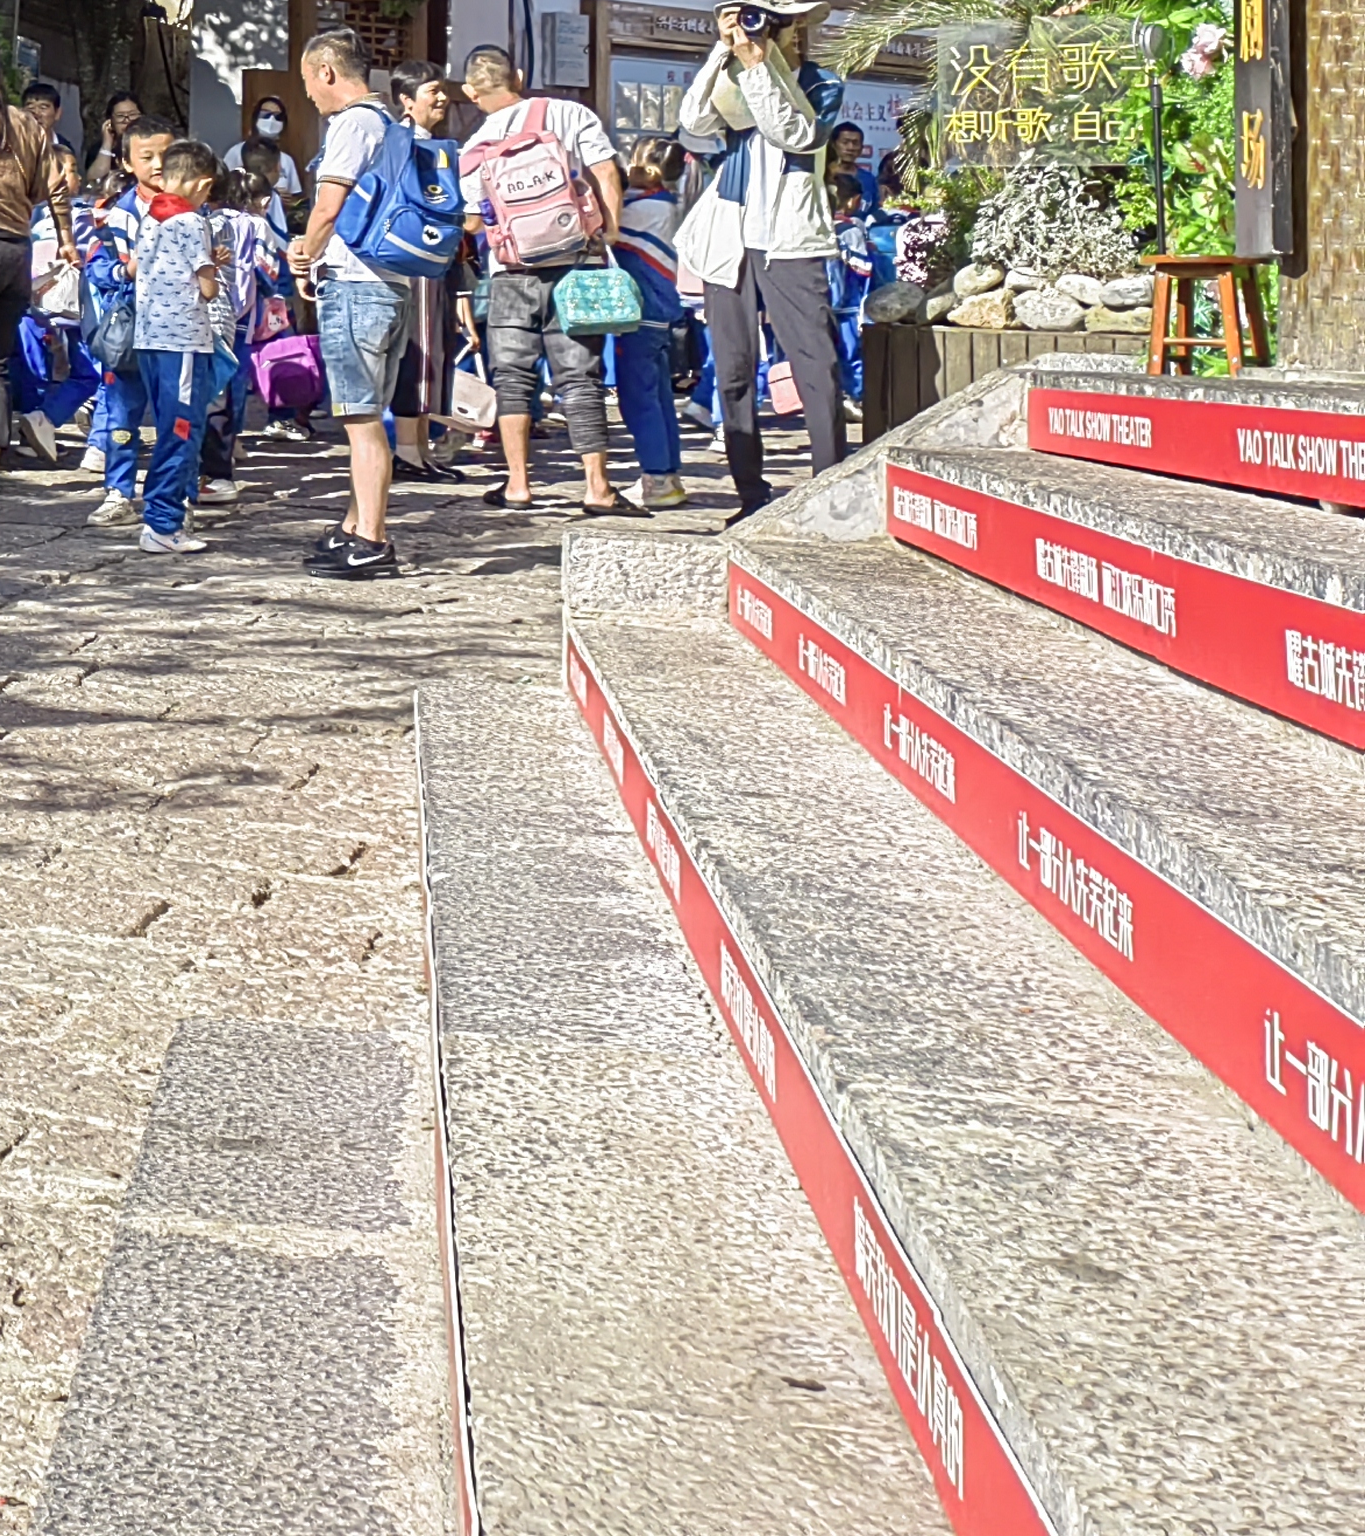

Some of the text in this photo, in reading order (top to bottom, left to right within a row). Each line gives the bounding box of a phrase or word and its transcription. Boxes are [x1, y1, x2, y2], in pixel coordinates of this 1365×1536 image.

[945, 103, 1135, 144] 想听歌 自己
[1048, 407, 1152, 448] YAO TALK SHOW THEATER
[1237, 428, 1263, 465] YAO
[1263, 431, 1298, 471] TALK
[1298, 436, 1338, 476] SHOW
[883, 703, 956, 804] 让一部分人先笑起来
[1018, 810, 1134, 962] 让一部分人先笑起来
[854, 1195, 964, 1501] 搞笑我们是认真的
